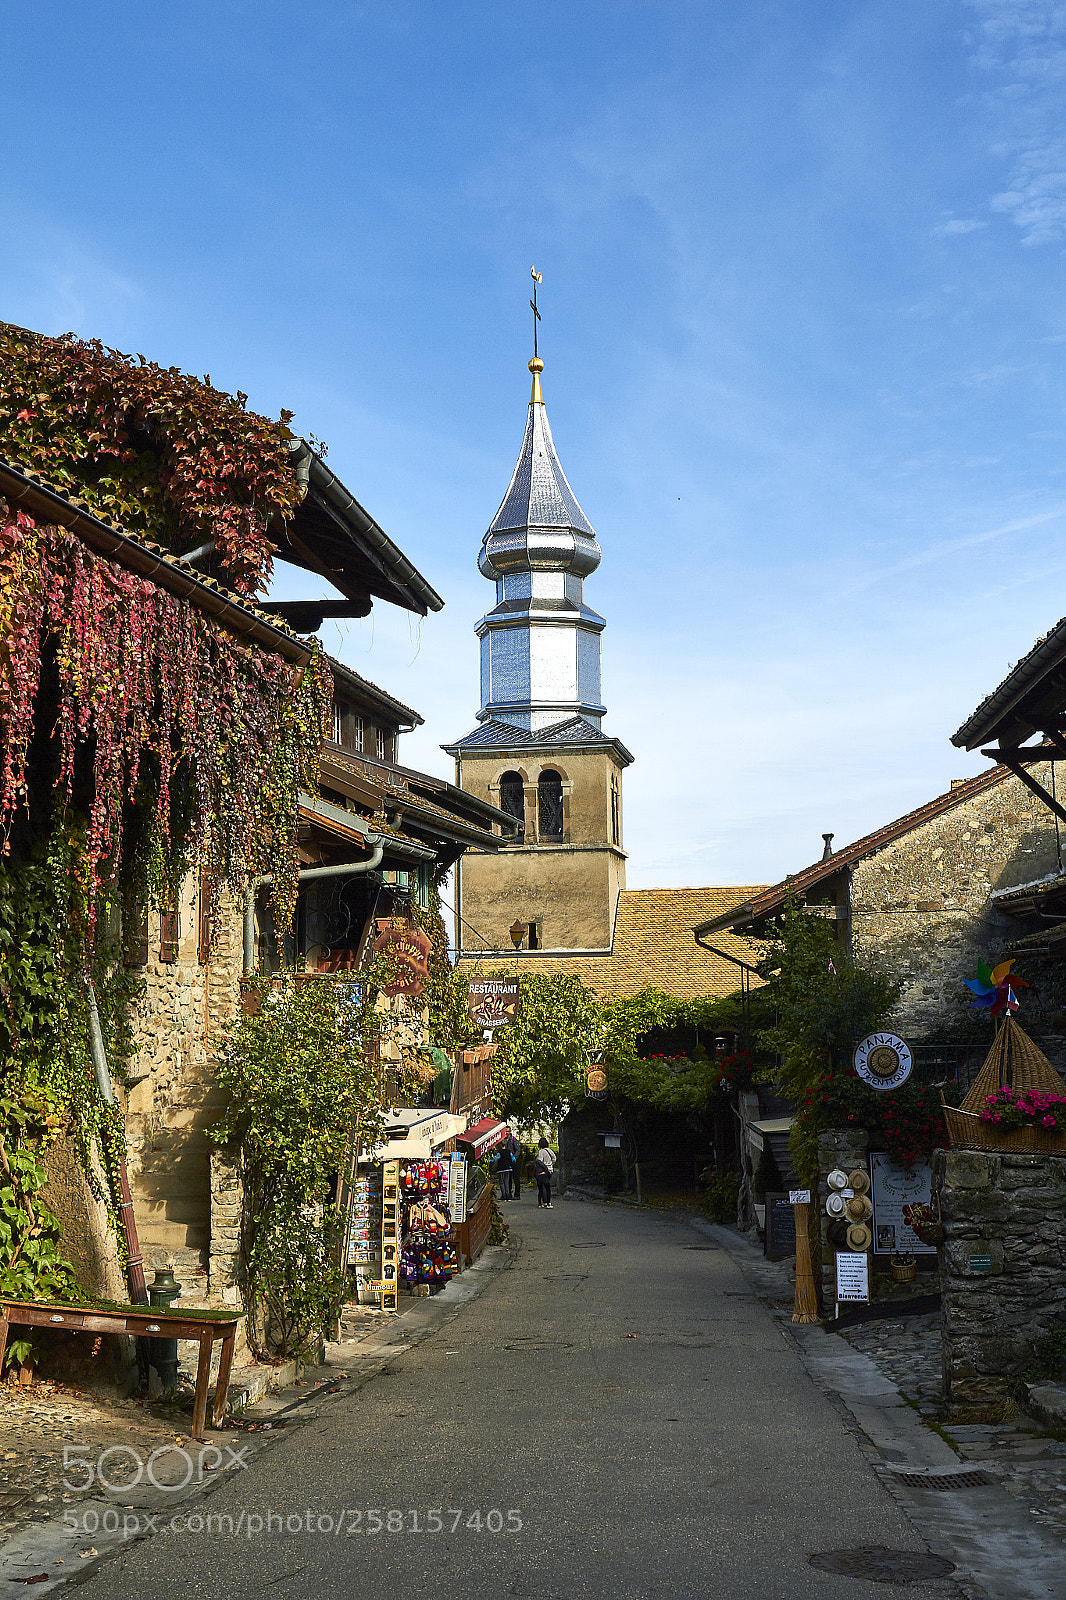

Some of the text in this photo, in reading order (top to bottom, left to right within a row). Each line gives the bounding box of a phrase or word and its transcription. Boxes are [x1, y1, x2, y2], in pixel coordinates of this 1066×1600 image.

[469, 984, 518, 994] RESTAURANT
[476, 1016, 510, 1027] BRASSERIE
[858, 1034, 910, 1061] PANAMA
[859, 1058, 907, 1086] AUTHENTIQUE
[367, 1280, 395, 1290] Humour
